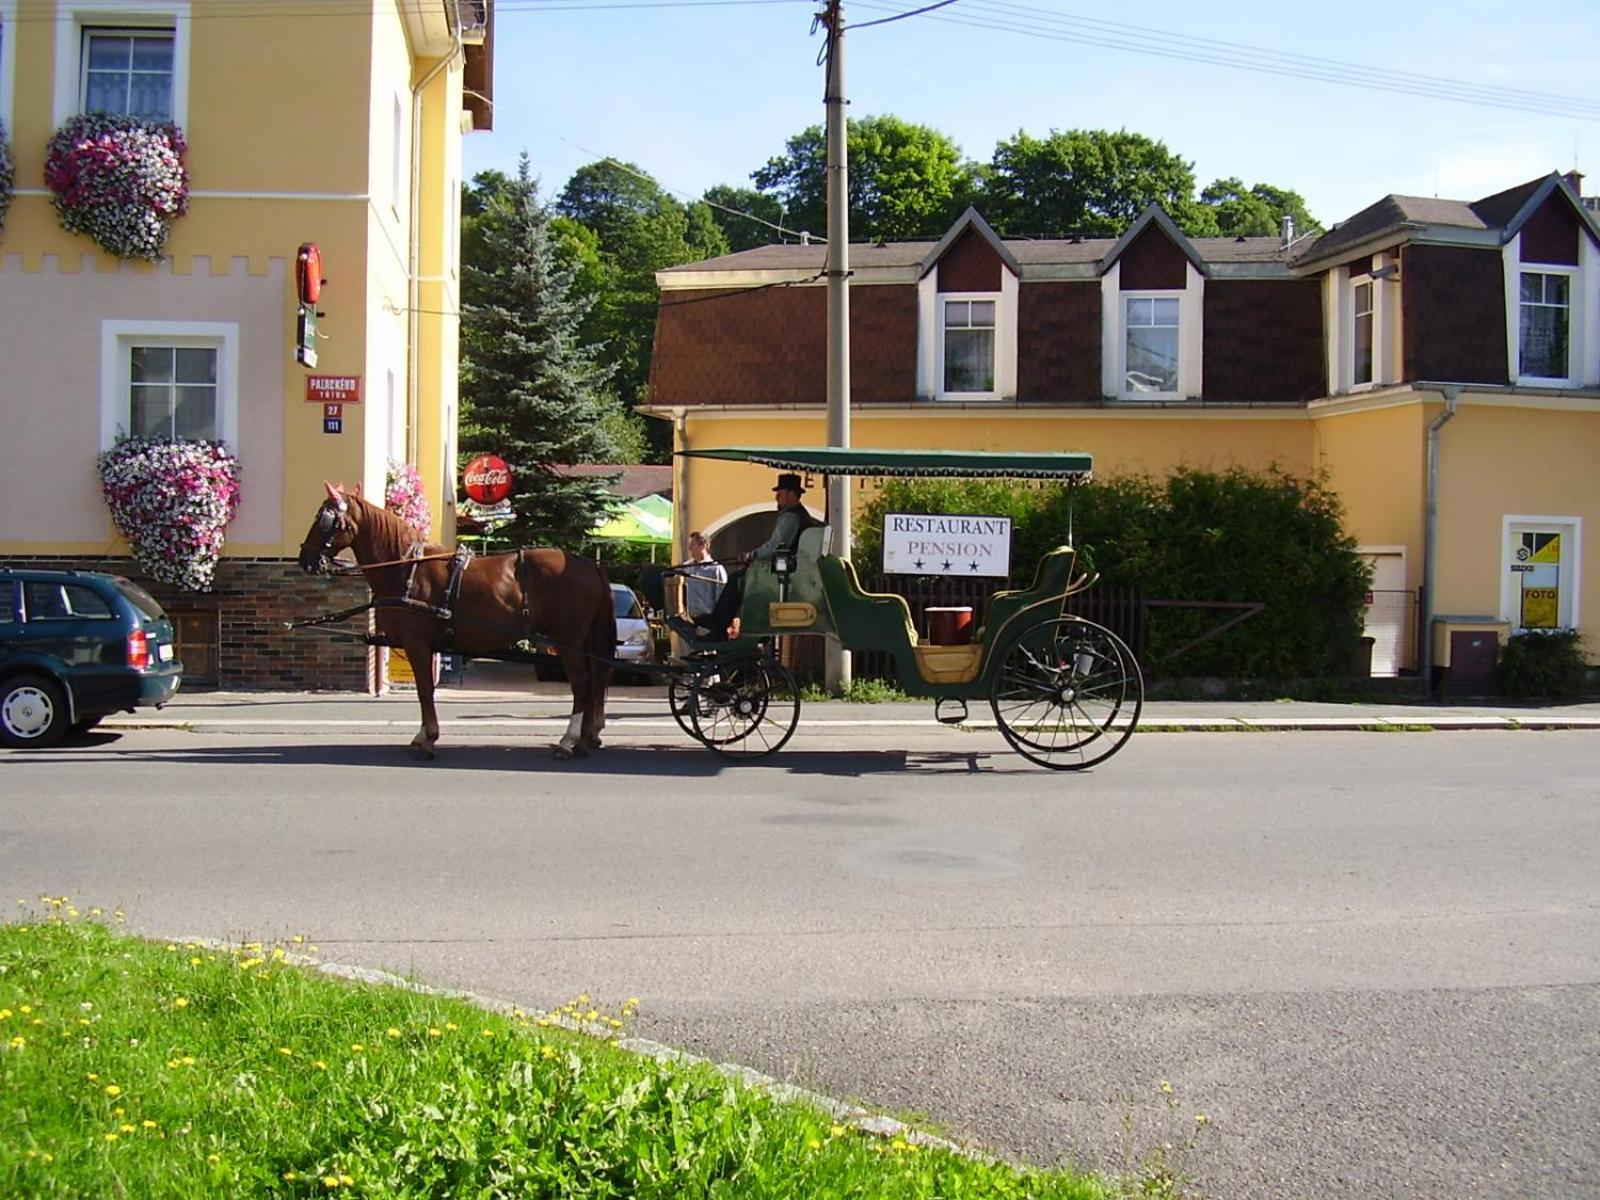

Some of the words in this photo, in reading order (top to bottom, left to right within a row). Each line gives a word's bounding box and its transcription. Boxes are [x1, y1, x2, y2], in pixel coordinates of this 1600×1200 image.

[328, 405, 338, 416] 27
[464, 469, 509, 487] Coca-Cola
[893, 517, 1008, 535] RESTAURANT
[908, 541, 993, 557] PENSION
[1525, 590, 1556, 600] FOTO
